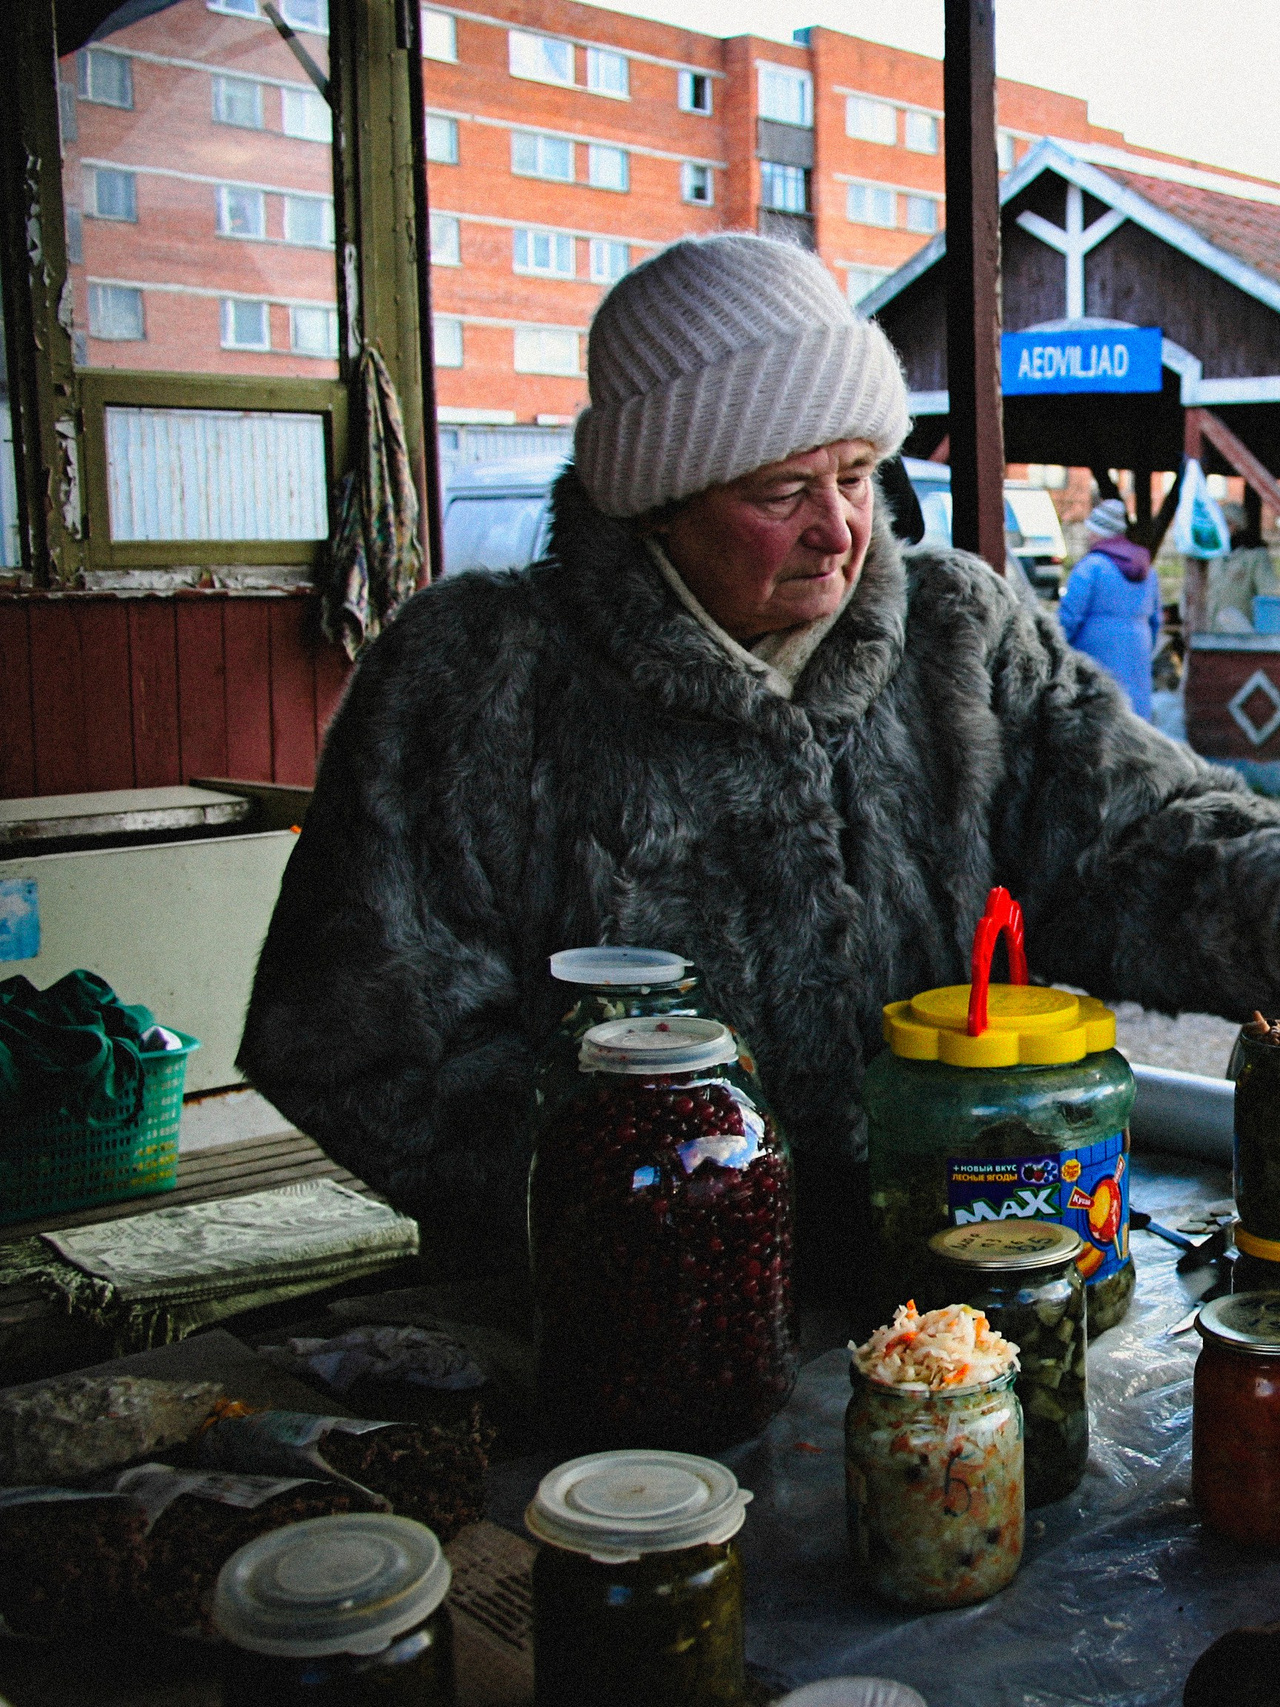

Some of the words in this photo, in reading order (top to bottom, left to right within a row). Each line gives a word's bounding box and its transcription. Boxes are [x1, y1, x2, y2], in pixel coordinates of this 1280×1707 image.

[1018, 344, 1130, 379] AEDVILJAD
[986, 1172, 1018, 1182] ЯГОДЫ
[995, 1164, 1018, 1172] ВКУС
[954, 1188, 1057, 1226] MAX
